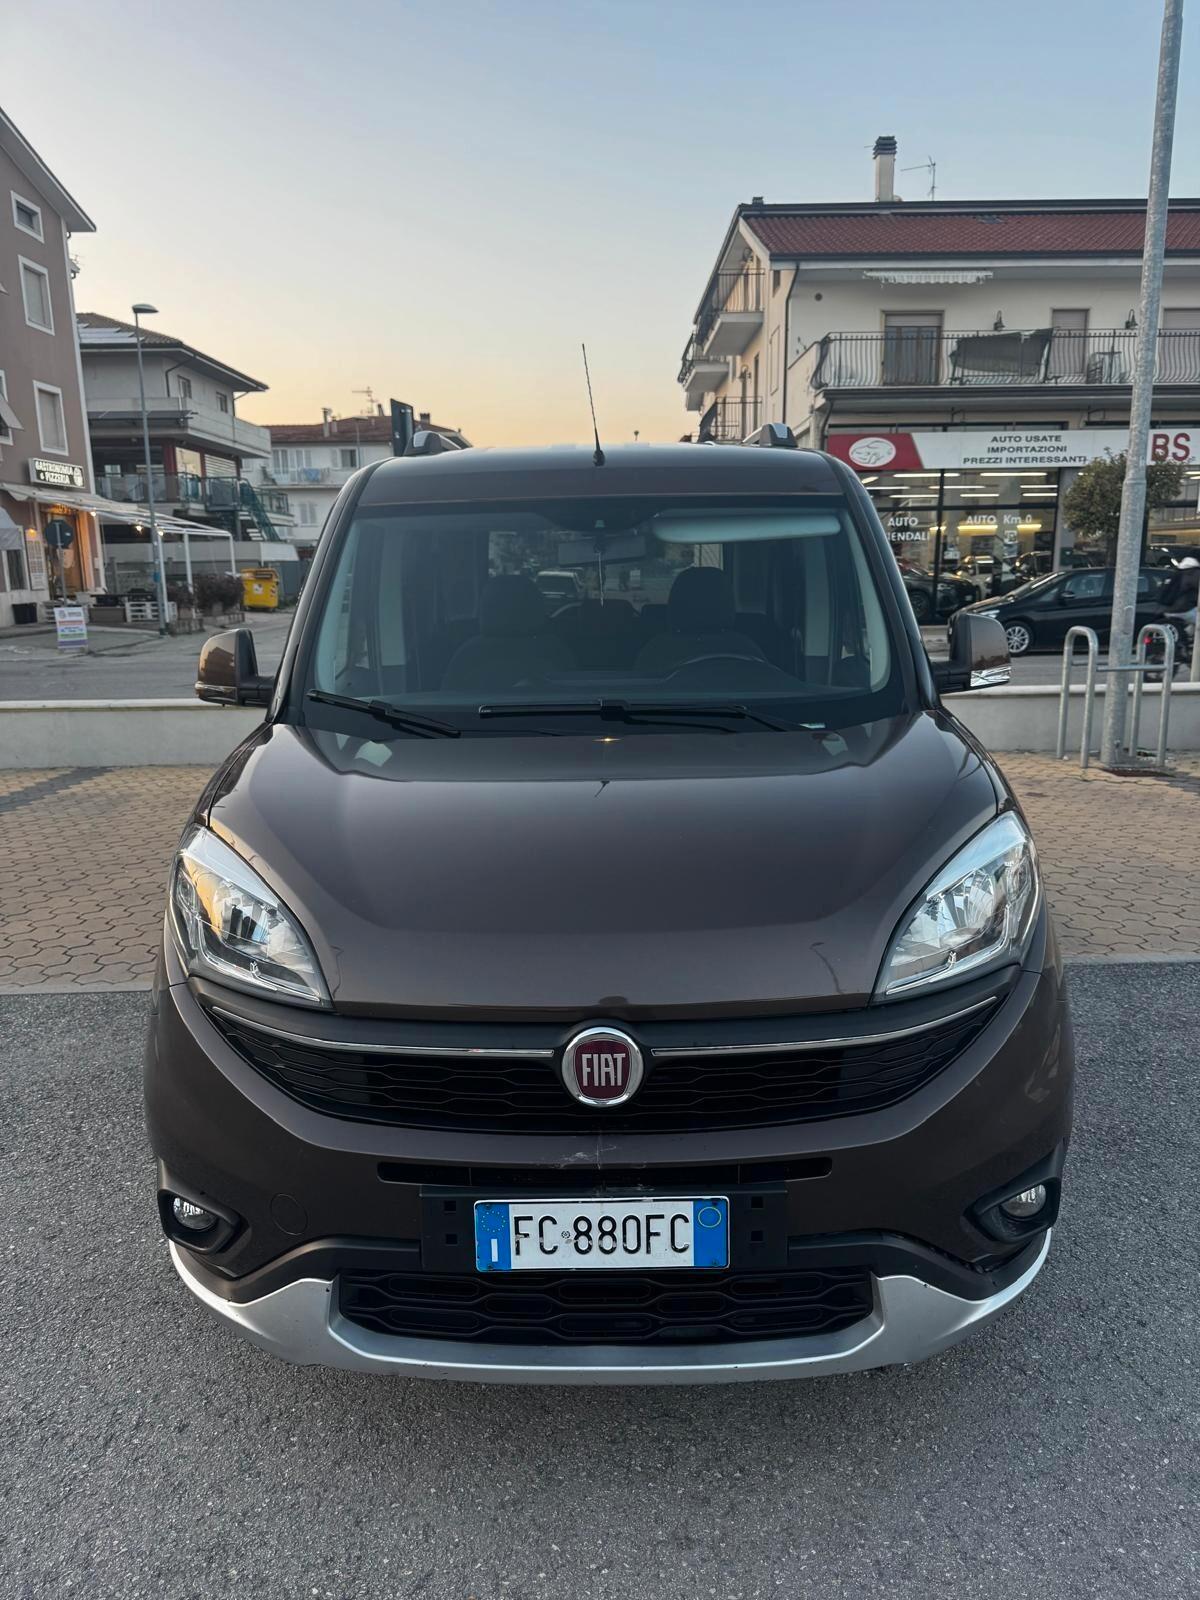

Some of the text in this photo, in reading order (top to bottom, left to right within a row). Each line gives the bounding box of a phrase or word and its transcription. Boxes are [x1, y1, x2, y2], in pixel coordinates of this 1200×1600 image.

[988, 446, 1067, 454] IMPORTAZIONI
[1151, 433, 1190, 461] BS
[1006, 456, 1087, 464] INTERESSANTI
[888, 517, 918, 526] AUTO
[966, 515, 997, 524] AUTO
[886, 532, 930, 542] IENDALI
[581, 1053, 626, 1086] FIAT
